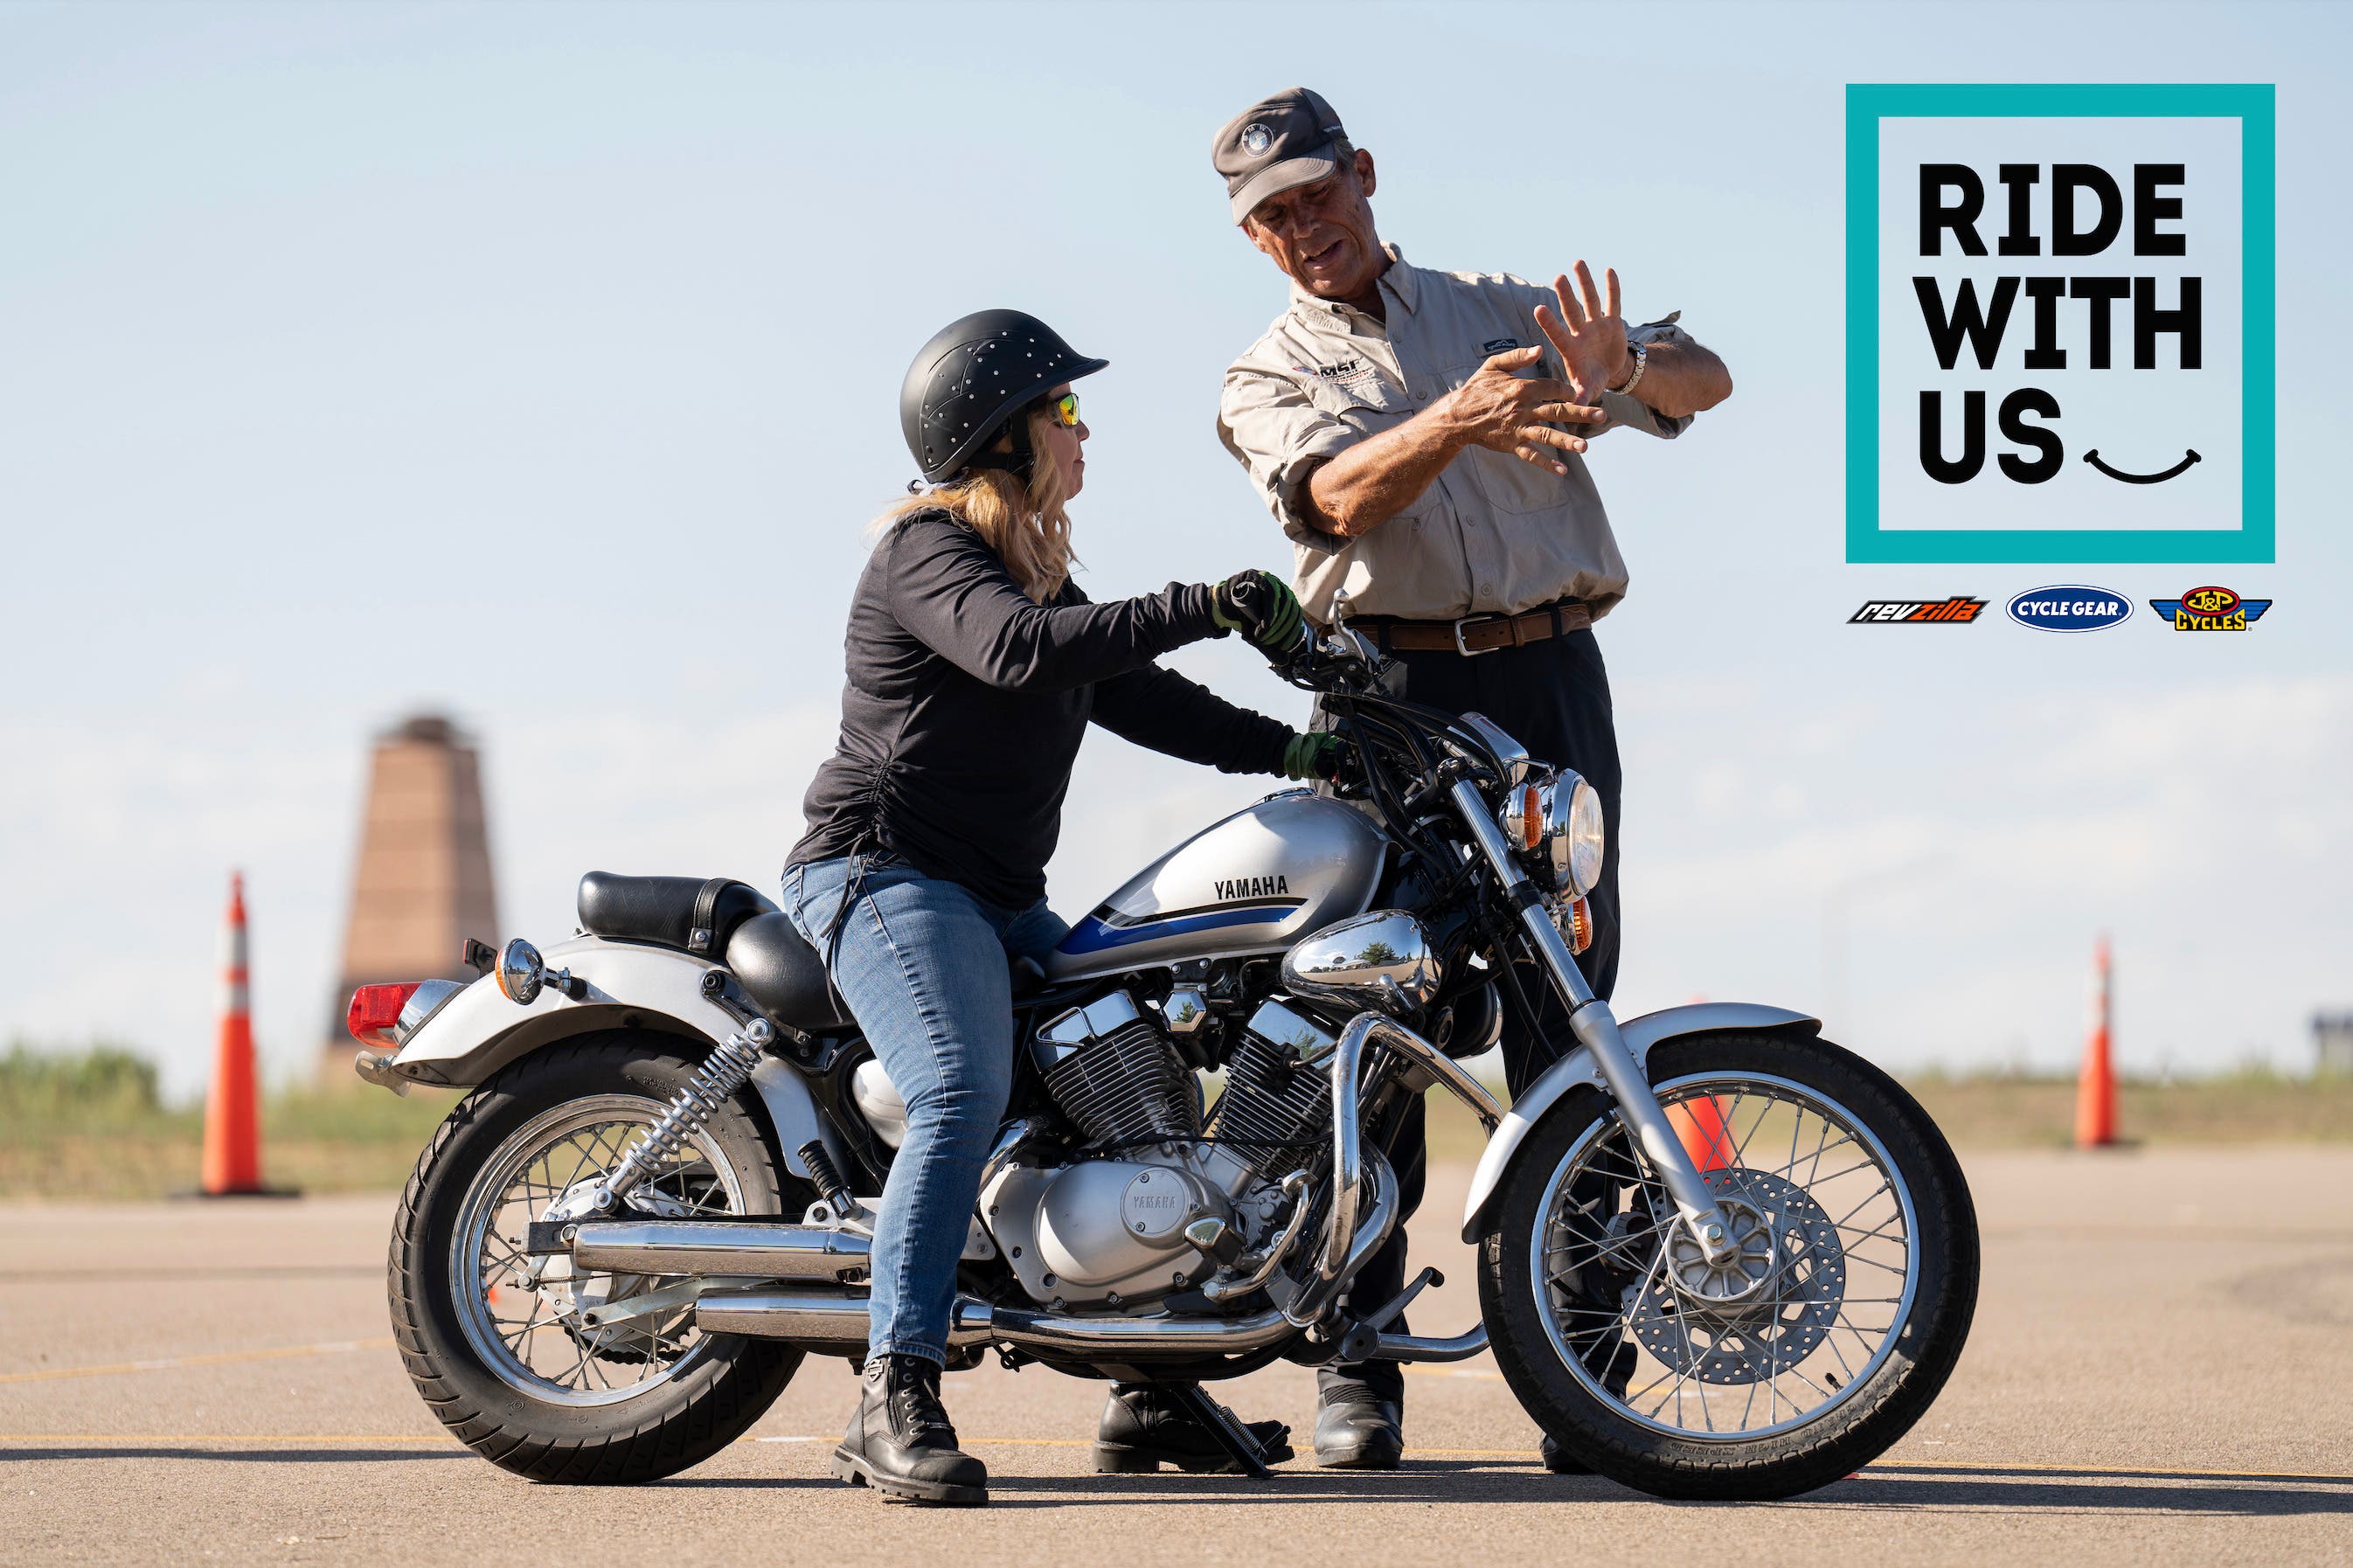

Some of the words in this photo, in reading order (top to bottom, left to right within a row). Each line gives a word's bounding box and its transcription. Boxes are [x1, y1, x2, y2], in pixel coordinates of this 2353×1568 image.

[1214, 875, 1289, 899] YAMAHA
[1134, 1196, 1176, 1209] YAMAHA
[1670, 1442, 1735, 1457] SPEED
[1745, 1436, 1792, 1456] HIGH
